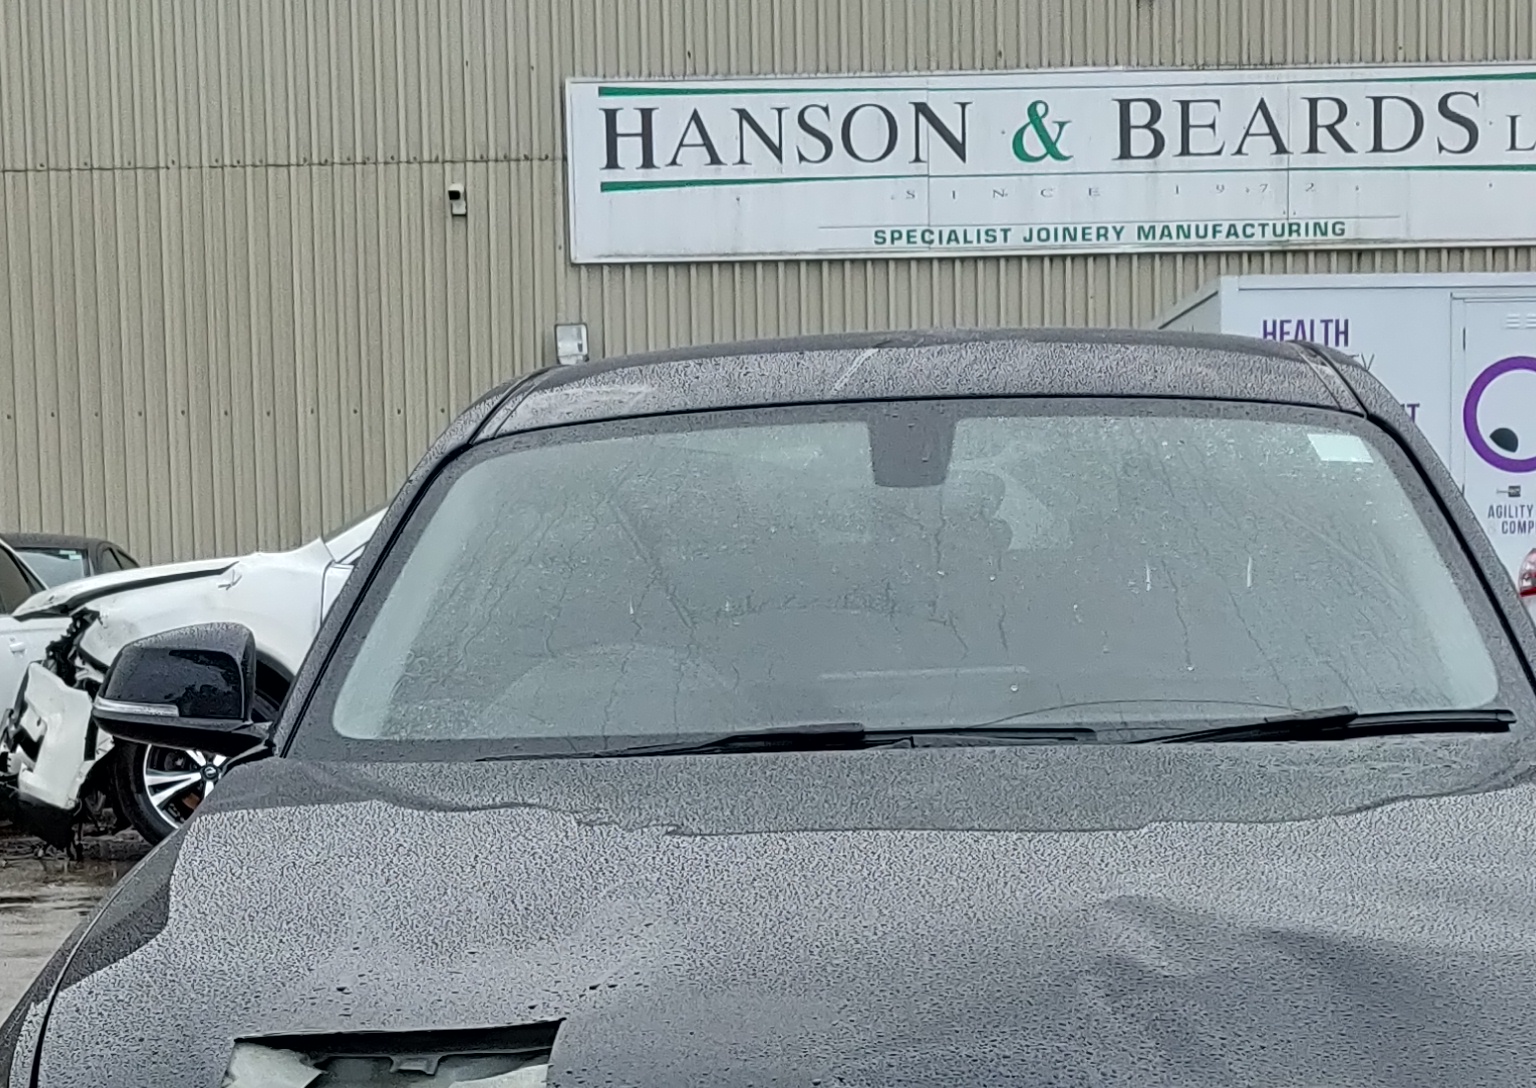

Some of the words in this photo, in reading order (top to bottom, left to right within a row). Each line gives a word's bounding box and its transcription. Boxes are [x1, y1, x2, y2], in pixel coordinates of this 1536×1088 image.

[599, 101, 973, 170] HANSON
[1012, 100, 1074, 163] &
[1112, 91, 1480, 161] BEARDS
[874, 227, 1012, 246] SPECIALIST
[1023, 226, 1126, 243] JOINERY
[1137, 221, 1346, 241] MANUFACTURING
[1487, 504, 1534, 519] AGILITY
